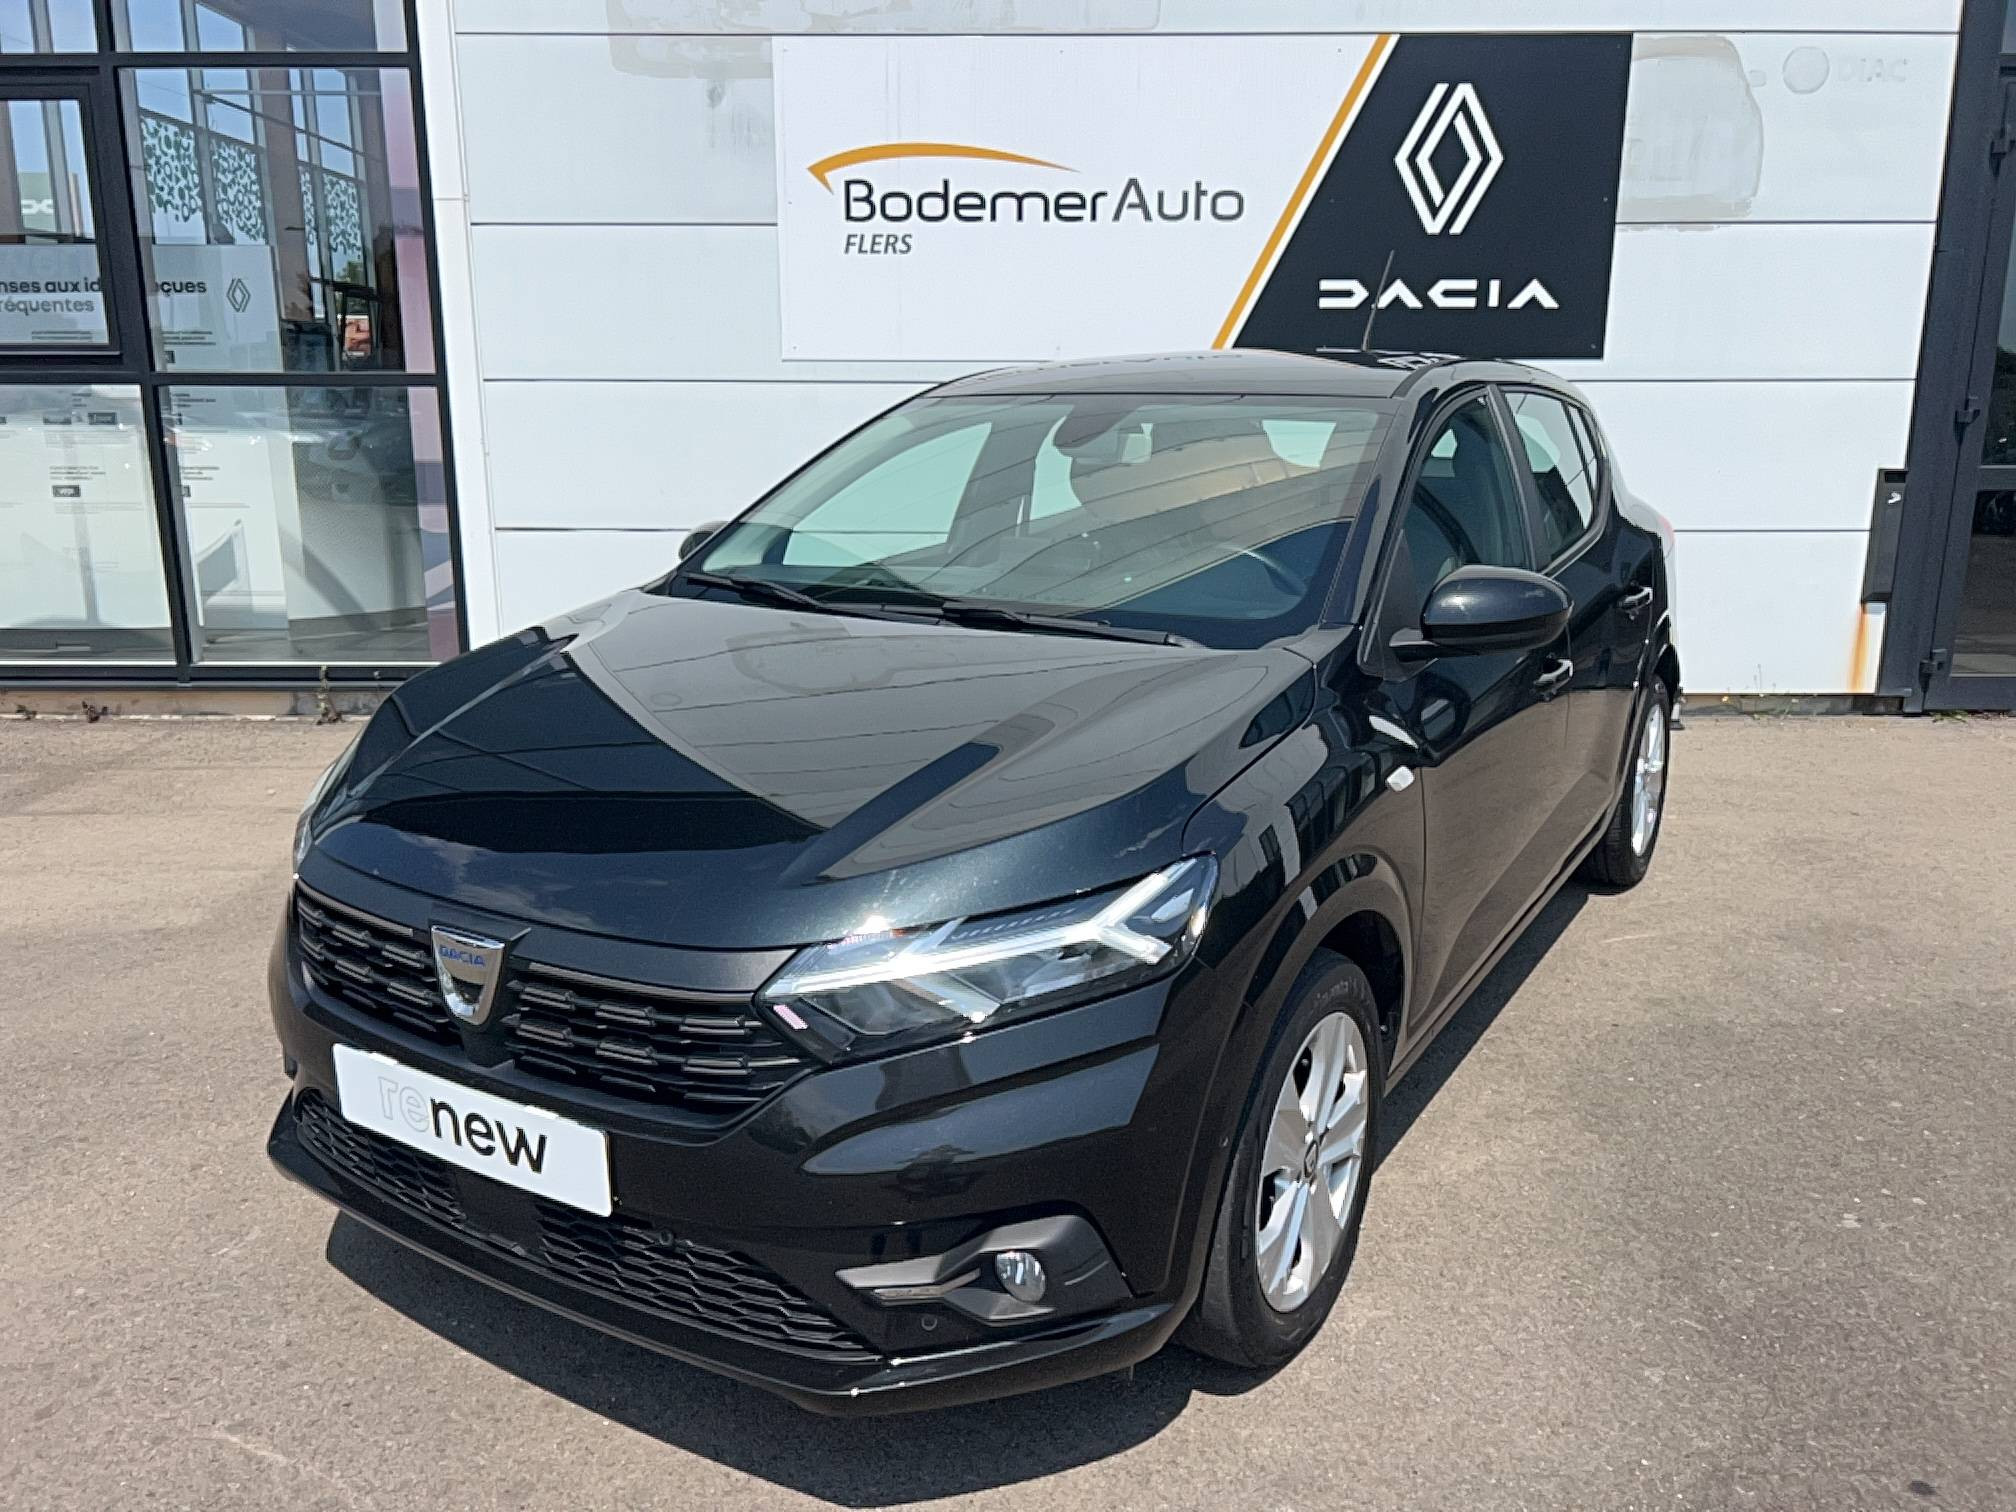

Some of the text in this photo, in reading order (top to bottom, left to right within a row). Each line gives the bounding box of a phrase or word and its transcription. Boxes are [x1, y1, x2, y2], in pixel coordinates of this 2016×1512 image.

[843, 233, 913, 255] FLERS
[44, 281, 81, 293] aux
[1318, 278, 1560, 310] DACIA
[377, 1076, 547, 1174] renew
